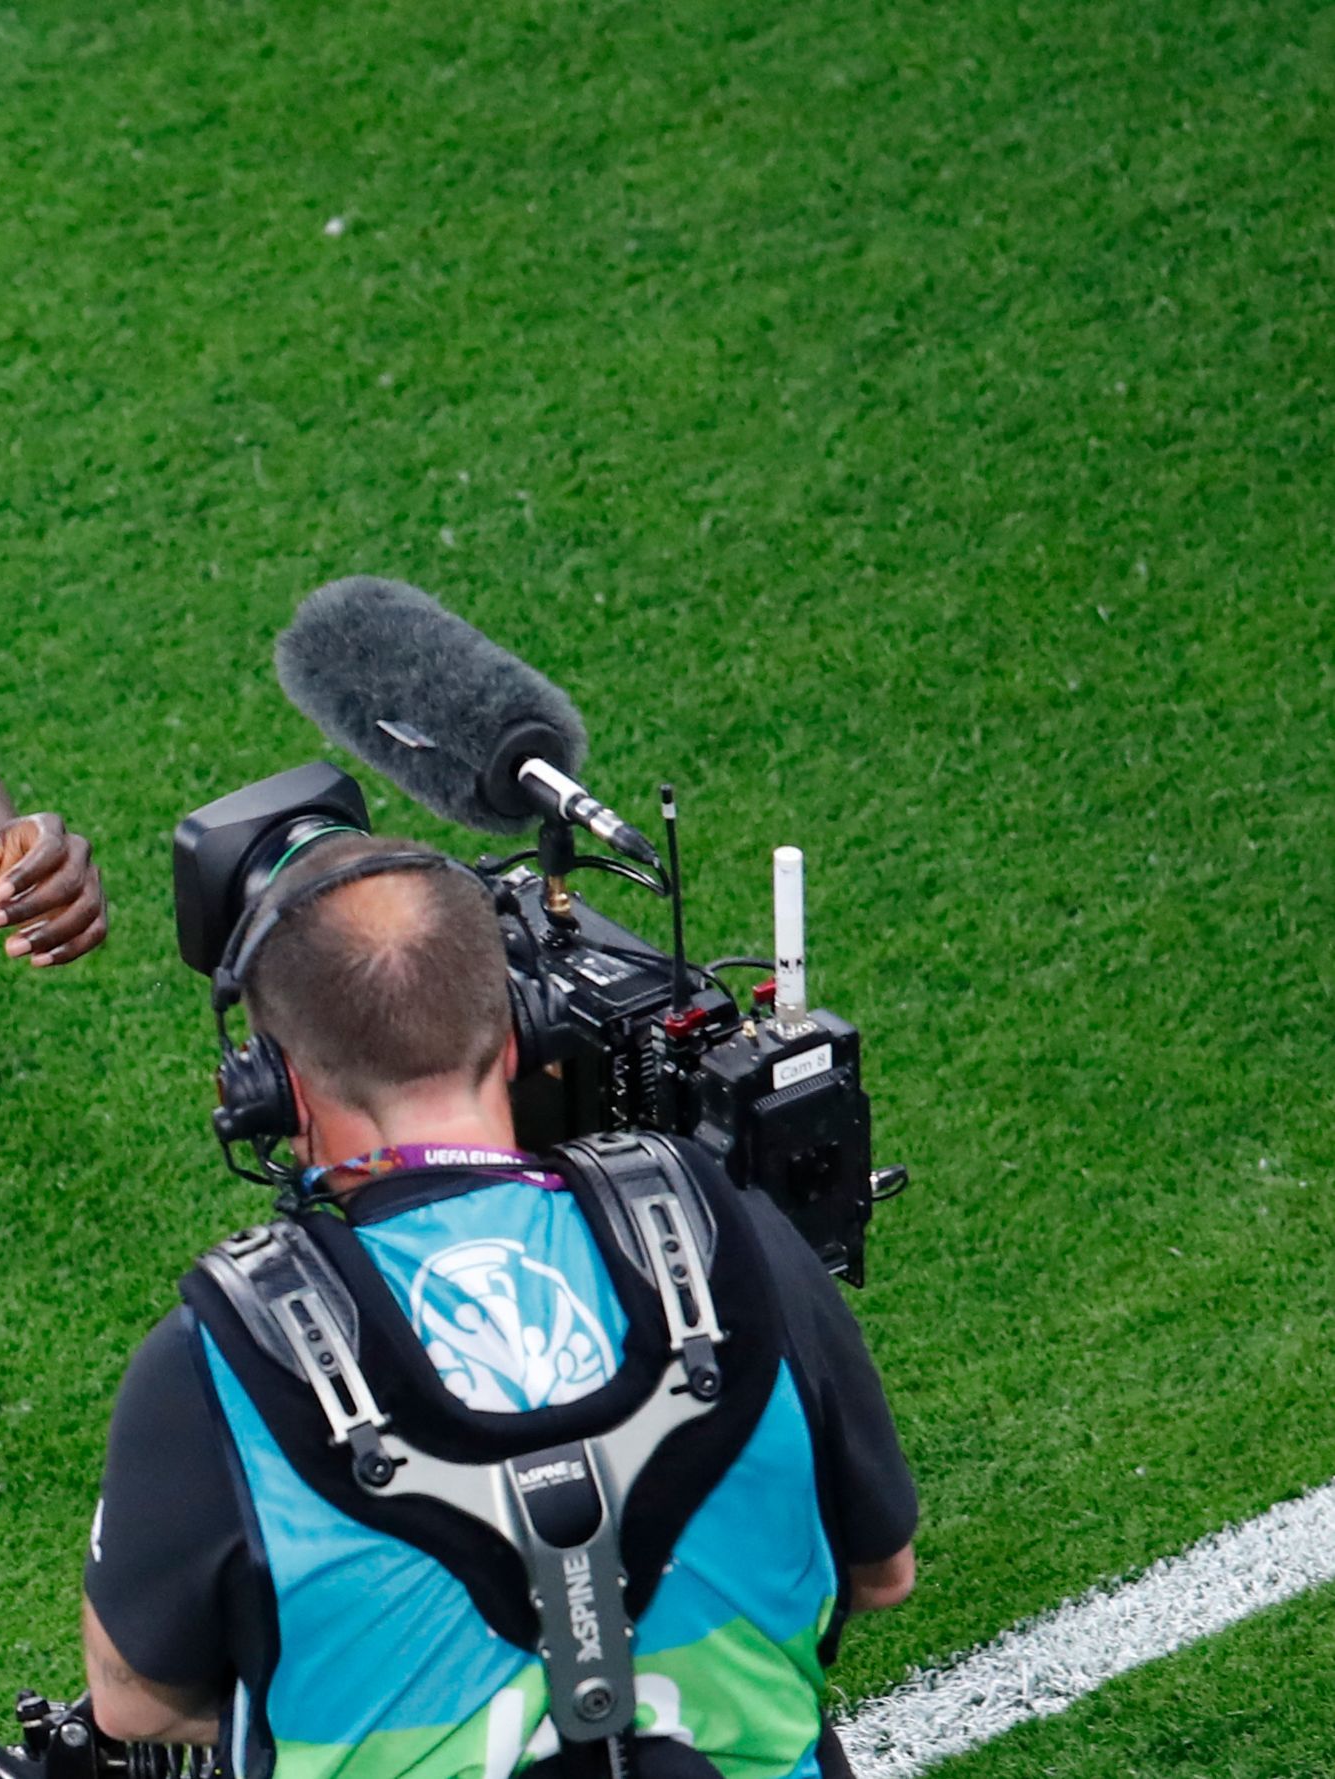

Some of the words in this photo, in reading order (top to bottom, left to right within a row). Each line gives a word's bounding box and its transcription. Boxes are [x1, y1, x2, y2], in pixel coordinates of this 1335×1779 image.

[780, 1061, 812, 1080] Cam
[817, 1053, 827, 1067] 8
[424, 1149, 468, 1165] UEFA
